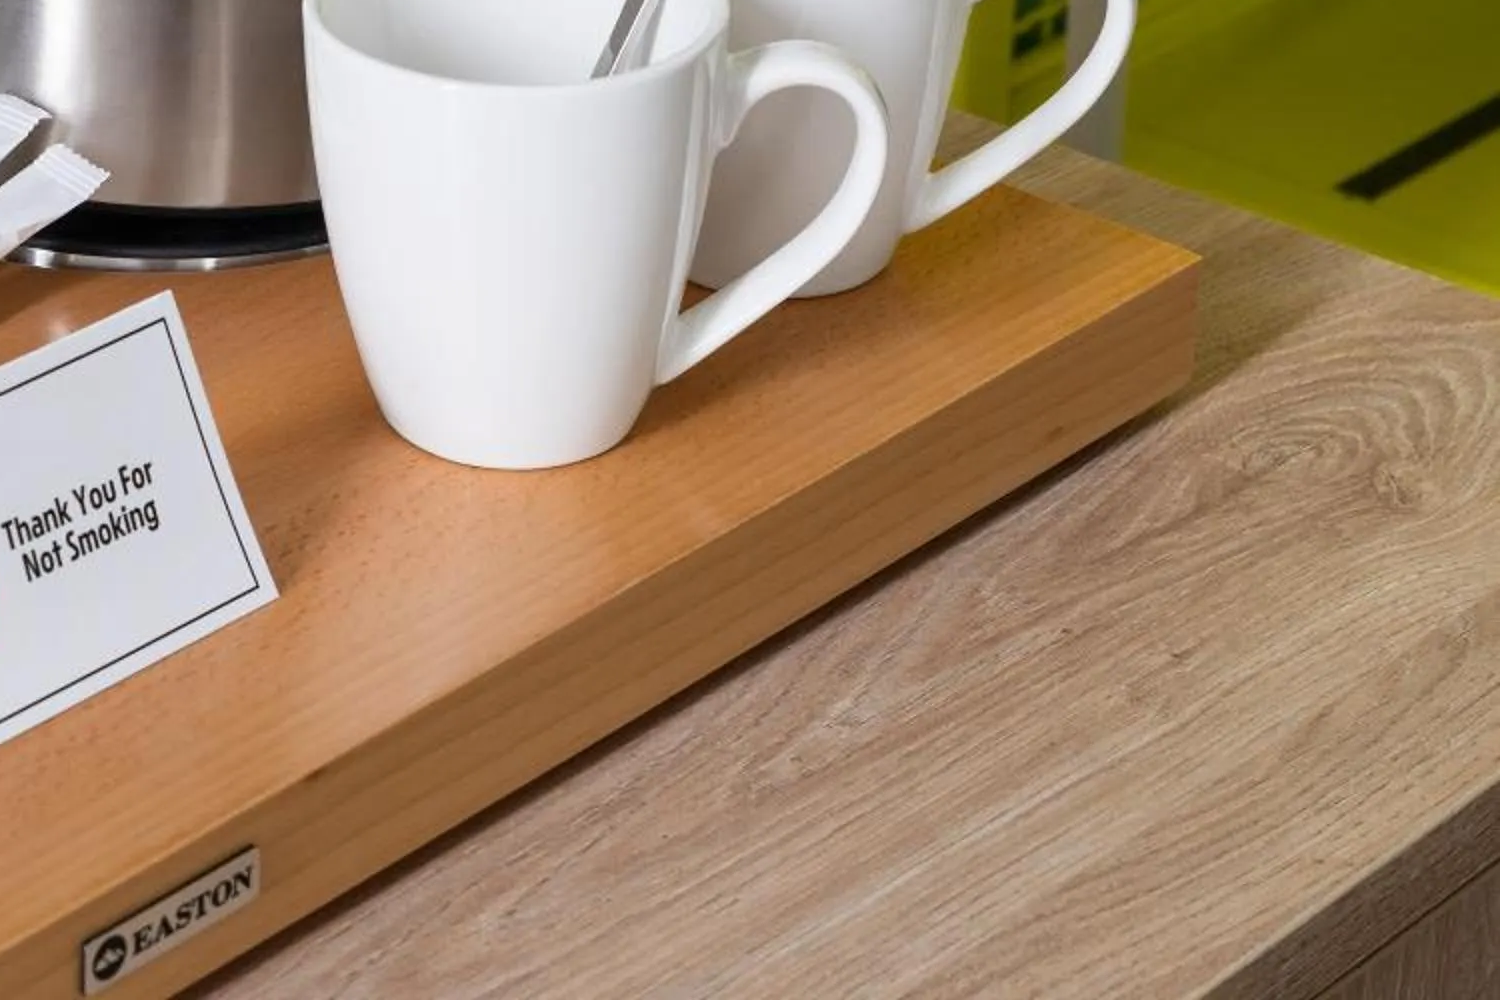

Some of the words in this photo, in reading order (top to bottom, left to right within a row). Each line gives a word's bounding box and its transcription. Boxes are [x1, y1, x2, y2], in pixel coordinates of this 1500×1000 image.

[1, 497, 72, 550] Thank
[72, 480, 117, 515] You
[118, 462, 152, 495] For
[22, 540, 63, 582] Not
[65, 500, 160, 561] Smoking
[132, 865, 253, 955] EASTON
